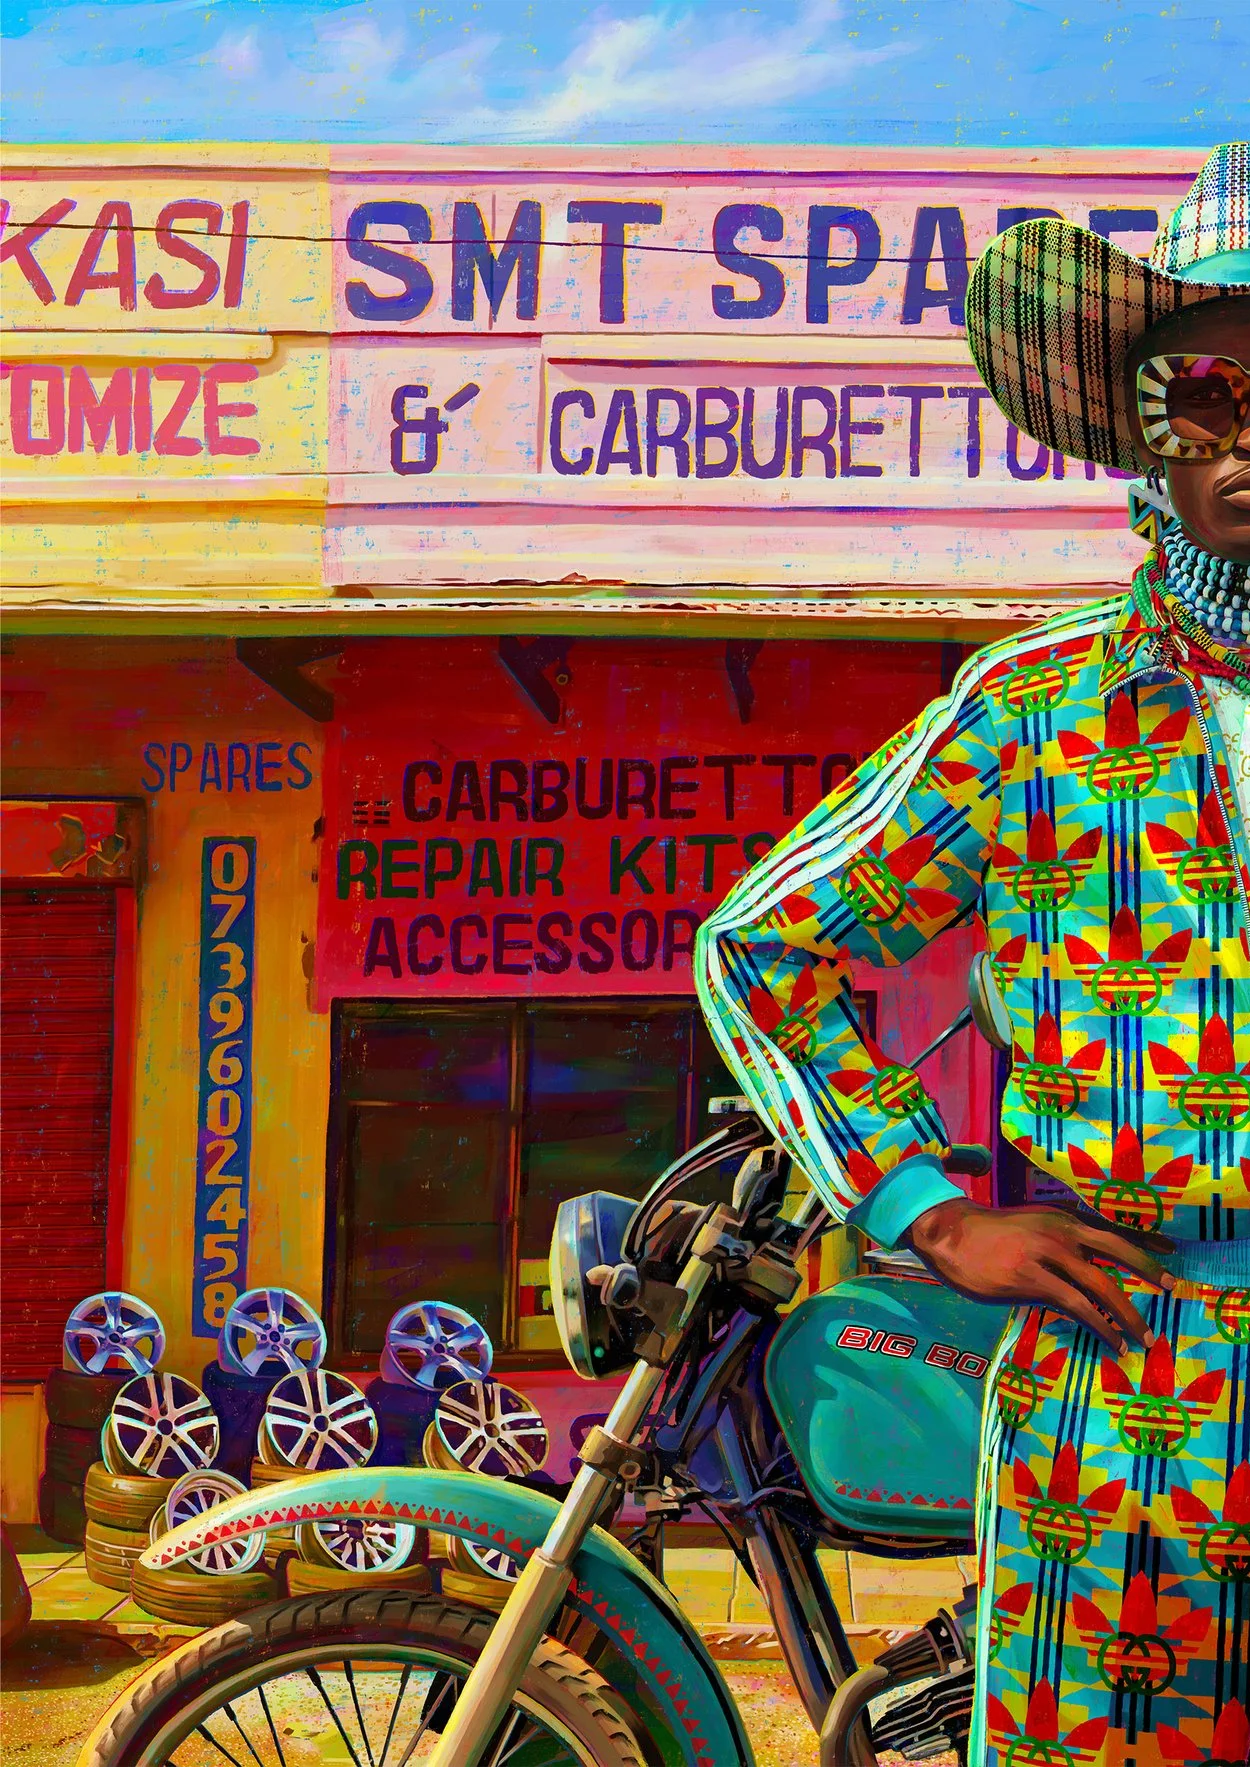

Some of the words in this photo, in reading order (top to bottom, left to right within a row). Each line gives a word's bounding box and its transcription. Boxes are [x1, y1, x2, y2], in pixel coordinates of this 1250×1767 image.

[345, 200, 663, 325] SMT
[711, 203, 1158, 326] SPA
[0, 362, 261, 456] OMIZE
[140, 741, 313, 793] SPARES
[402, 752, 870, 823] CARBURETTO
[335, 836, 565, 901] REPAIR
[363, 909, 700, 979] ACCESSOR
[202, 843, 250, 1329] 0739602458
[837, 1325, 917, 1358] BIG
[924, 1342, 991, 1379] BO
